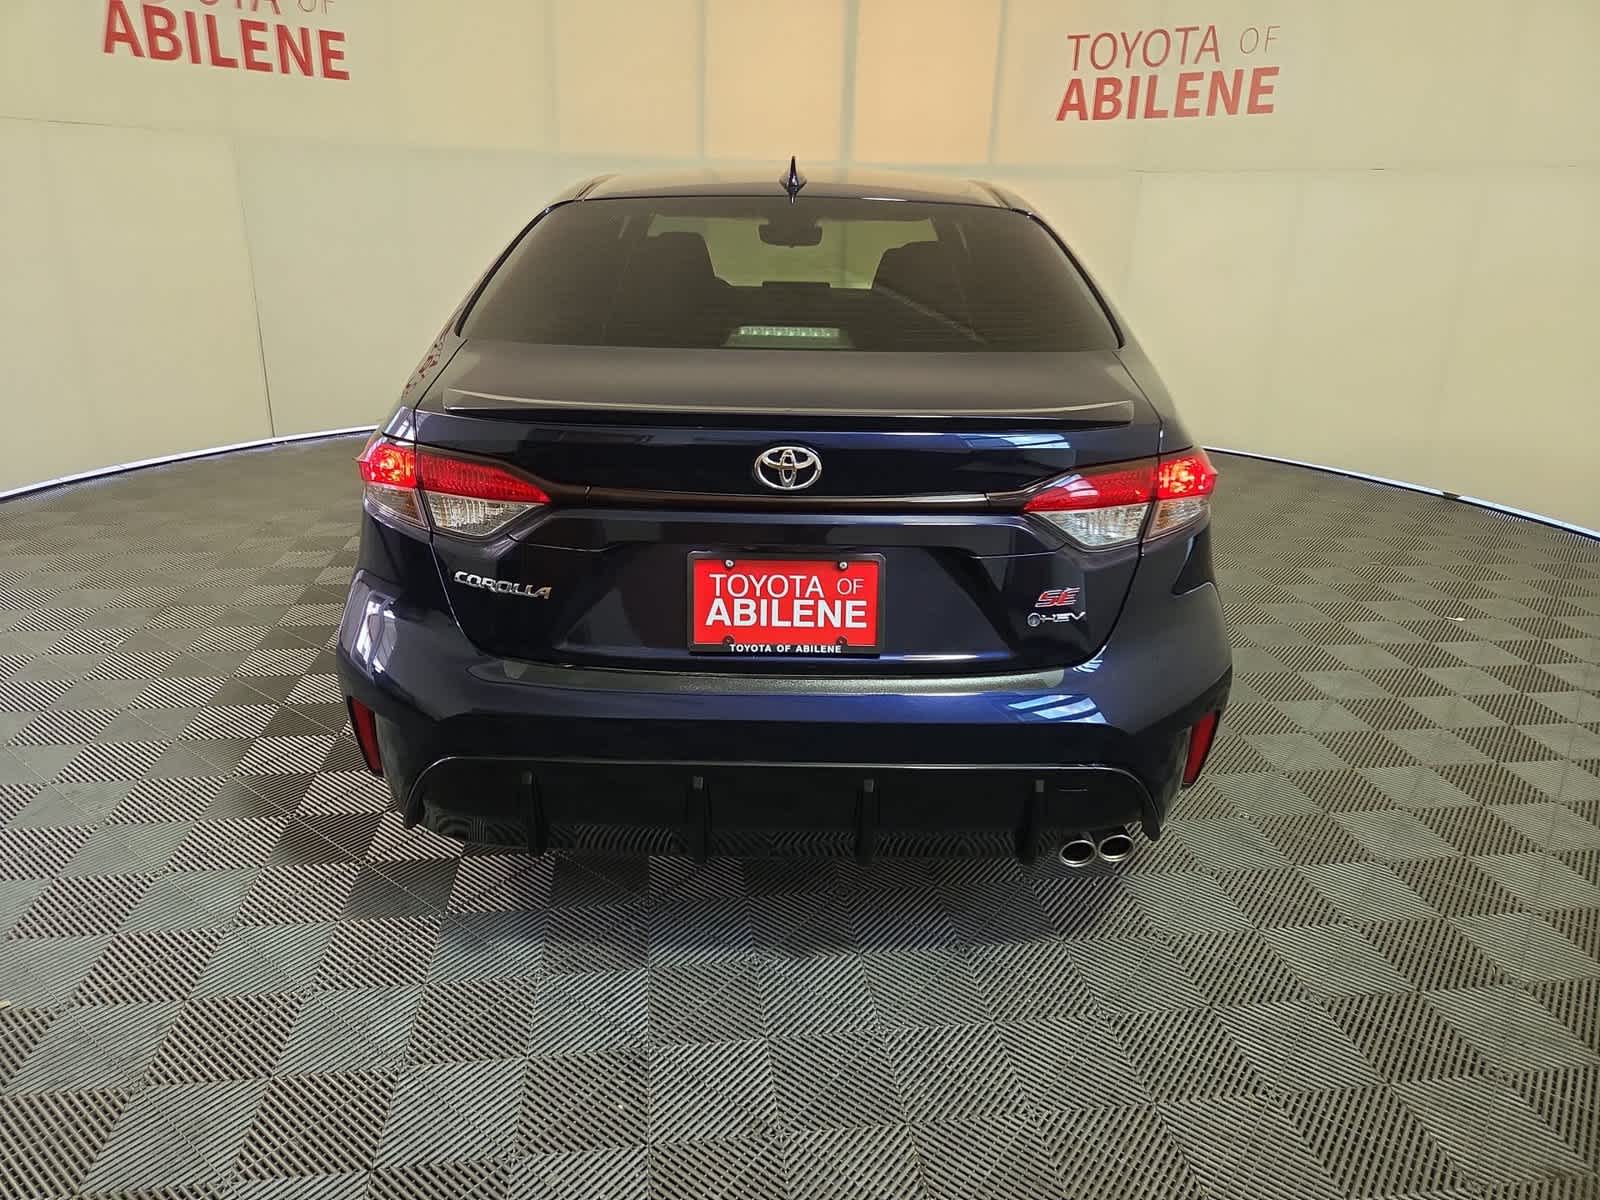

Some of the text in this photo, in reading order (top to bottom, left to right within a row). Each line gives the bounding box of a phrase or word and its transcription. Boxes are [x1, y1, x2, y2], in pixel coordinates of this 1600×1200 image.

[103, 0, 351, 81] ABILENE
[1067, 25, 1281, 71] TOYOTA OF
[1056, 66, 1280, 121] ABILENE
[453, 570, 552, 600] COROLLA
[709, 573, 865, 598] TOYOTA OF
[1034, 587, 1080, 608] SE
[705, 598, 867, 628] ABILENE
[729, 643, 842, 654] TOYOTA OF ABILENE
